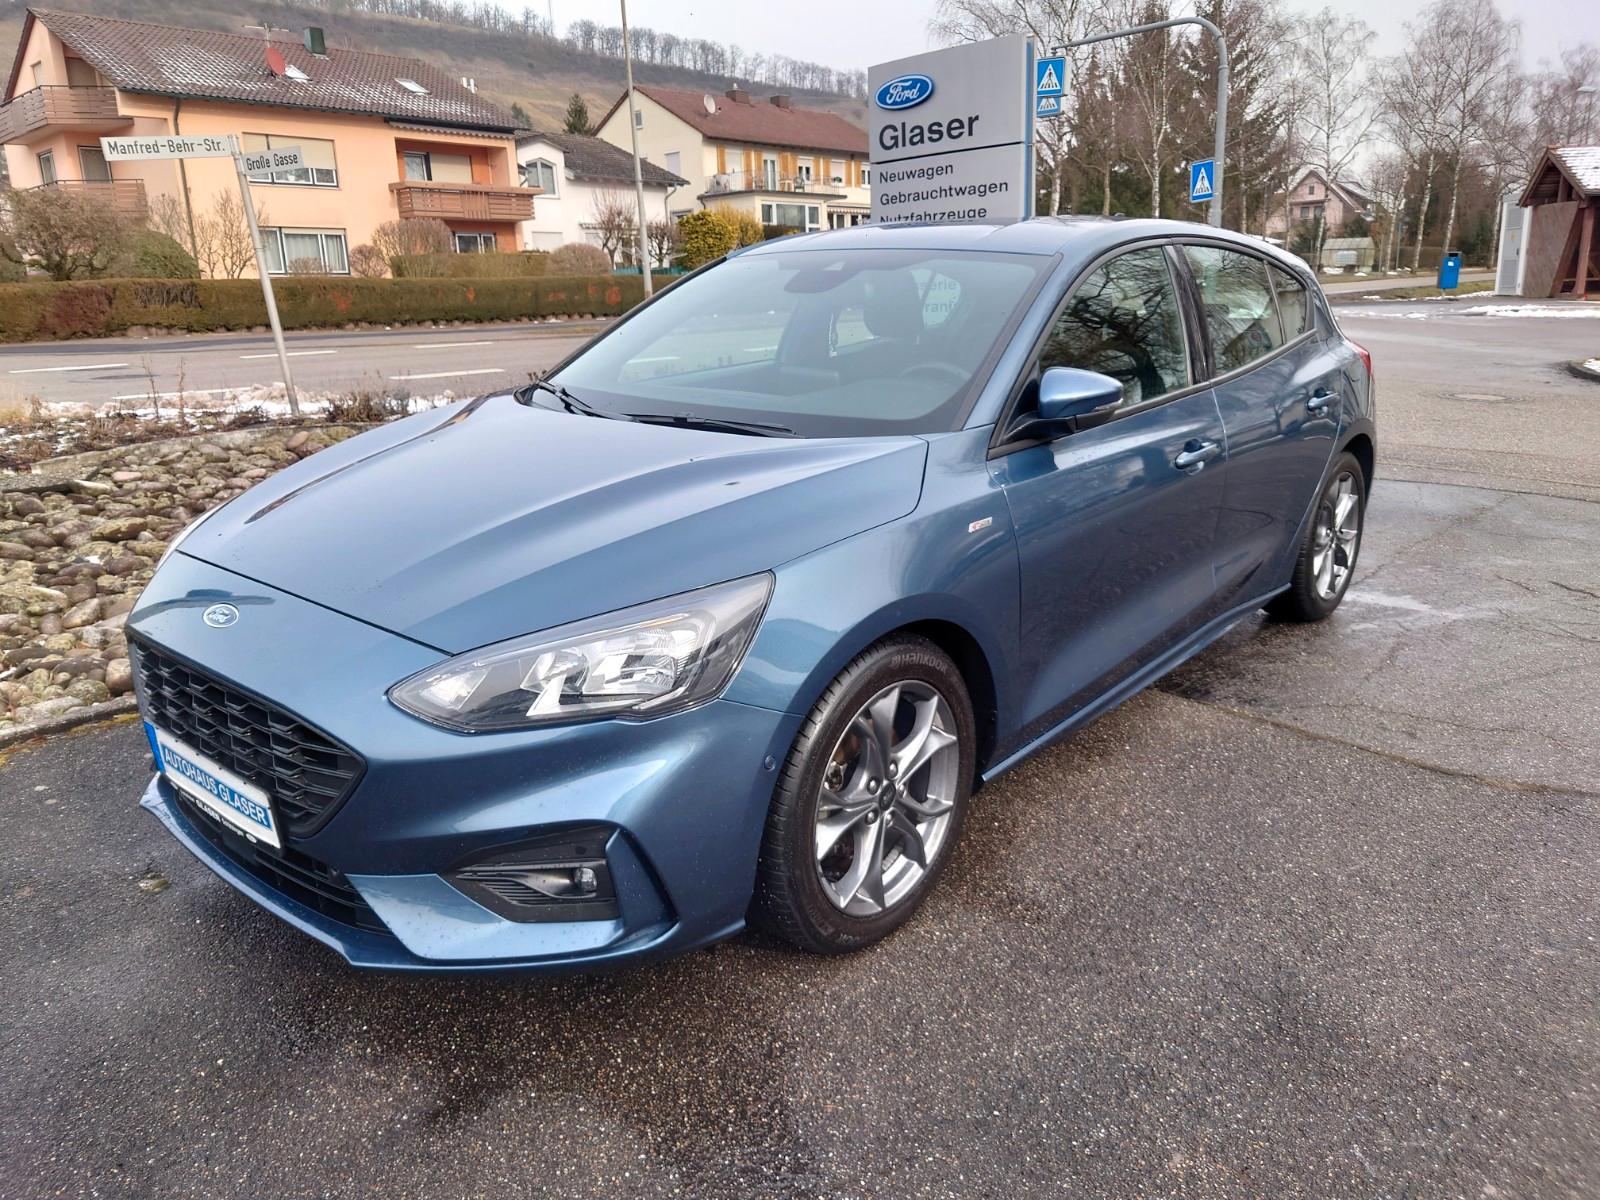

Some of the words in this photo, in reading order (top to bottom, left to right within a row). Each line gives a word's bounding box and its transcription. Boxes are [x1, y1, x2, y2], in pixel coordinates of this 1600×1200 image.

[886, 80, 921, 104] Ford
[879, 115, 979, 150] Glaser
[107, 138, 226, 156] Manfred-Behr-Str.
[246, 157, 271, 172] Große
[273, 152, 299, 167] Gasse
[879, 163, 954, 184] Neuwagen
[880, 181, 1009, 206] Gebrauchtwagen
[165, 748, 217, 795] AUTOHAUS
[218, 783, 268, 826] GLASER
